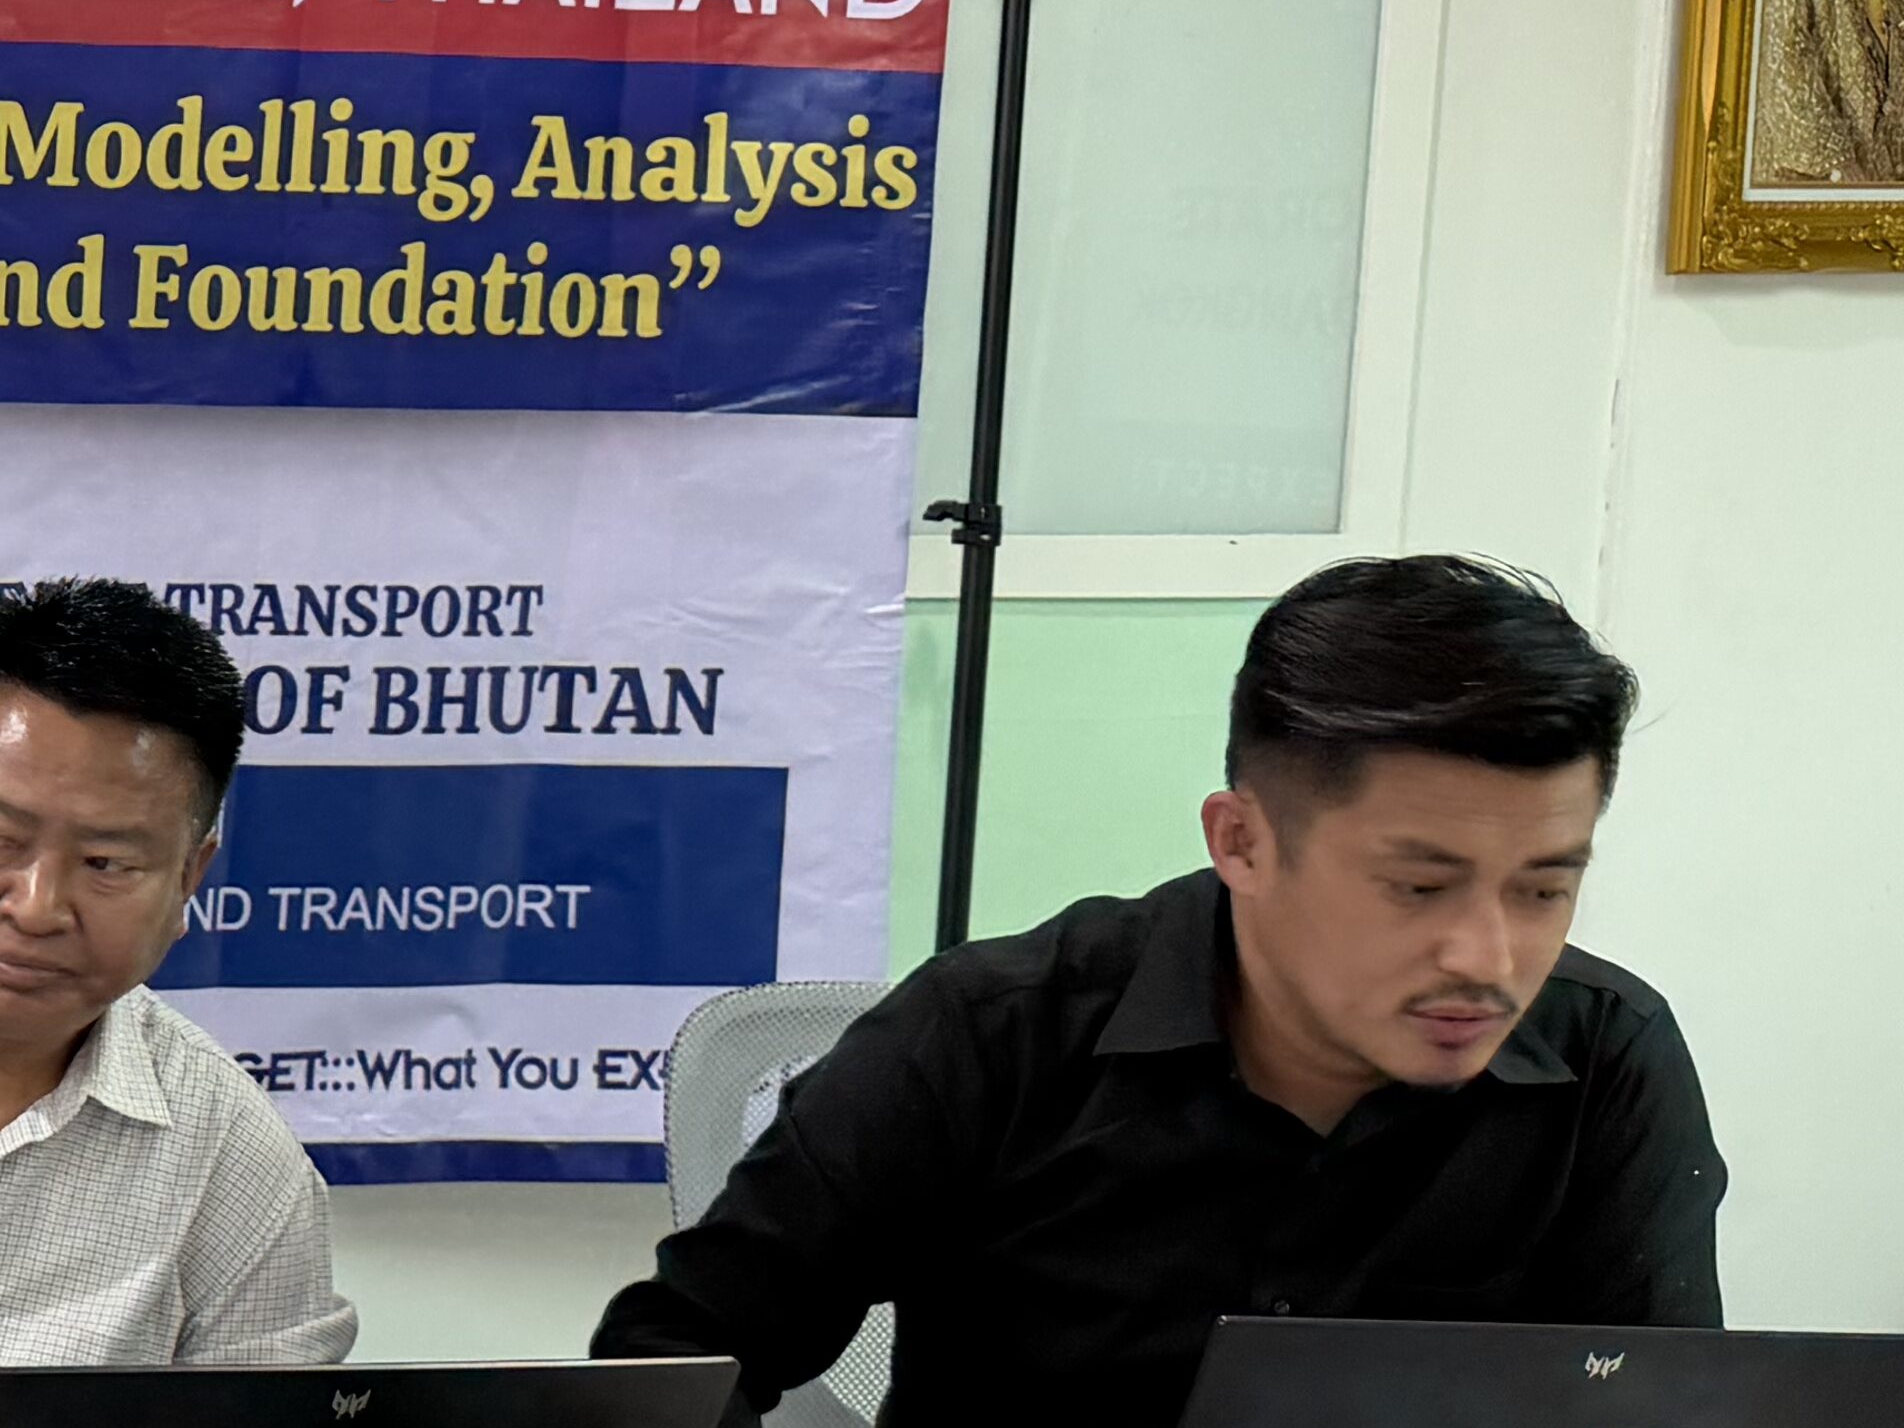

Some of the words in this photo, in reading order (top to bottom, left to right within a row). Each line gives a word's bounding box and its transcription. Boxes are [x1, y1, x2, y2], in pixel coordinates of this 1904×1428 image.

[512, 114, 920, 227] Analysis
[164, 582, 544, 638] TRANSPORT
[242, 665, 352, 738] OF
[368, 665, 727, 739] BHUTAN
[182, 887, 253, 932] ND
[267, 884, 592, 932] TRANSPORT
[487, 1048, 580, 1091] You
